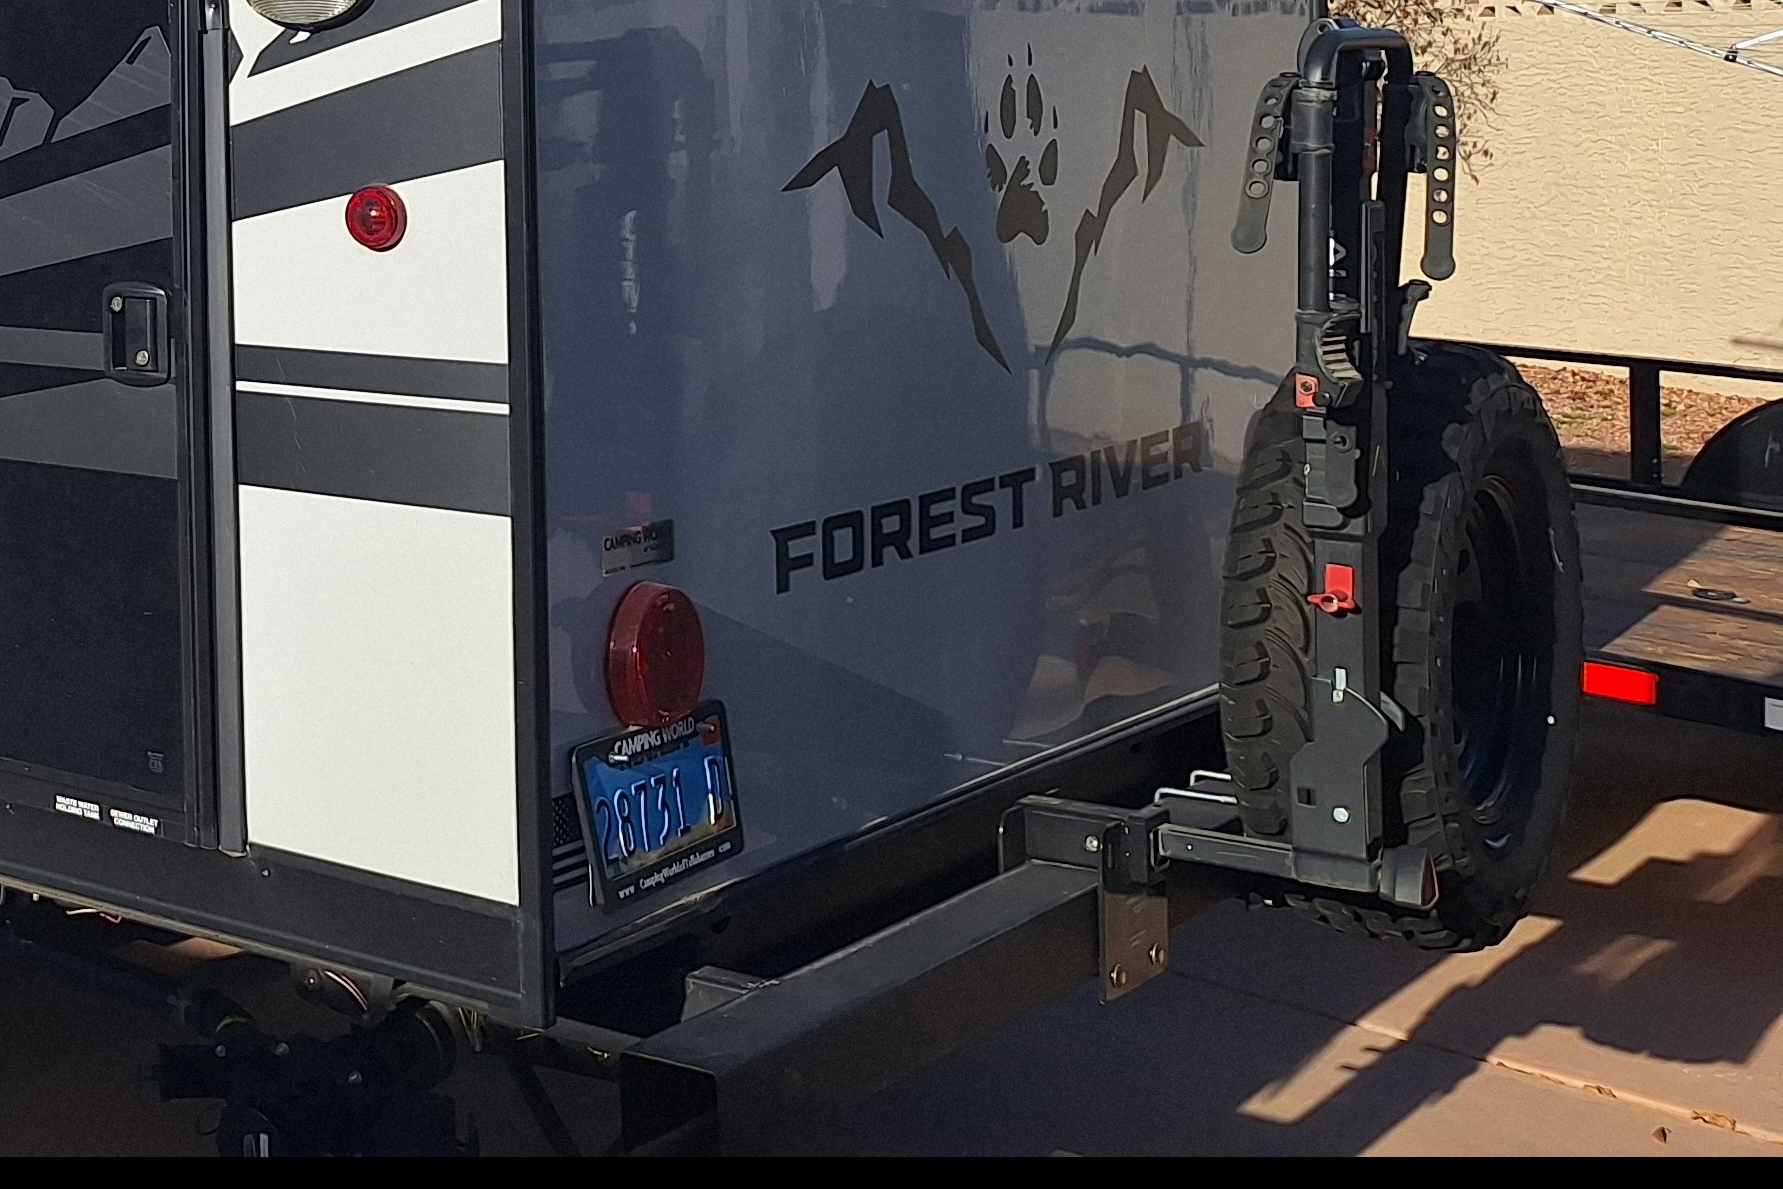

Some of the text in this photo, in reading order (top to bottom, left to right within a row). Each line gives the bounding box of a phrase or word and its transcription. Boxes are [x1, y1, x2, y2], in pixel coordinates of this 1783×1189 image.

[769, 420, 1204, 595] FOREST RIVER
[662, 716, 695, 743] WORLD
[595, 767, 692, 868] 28731
